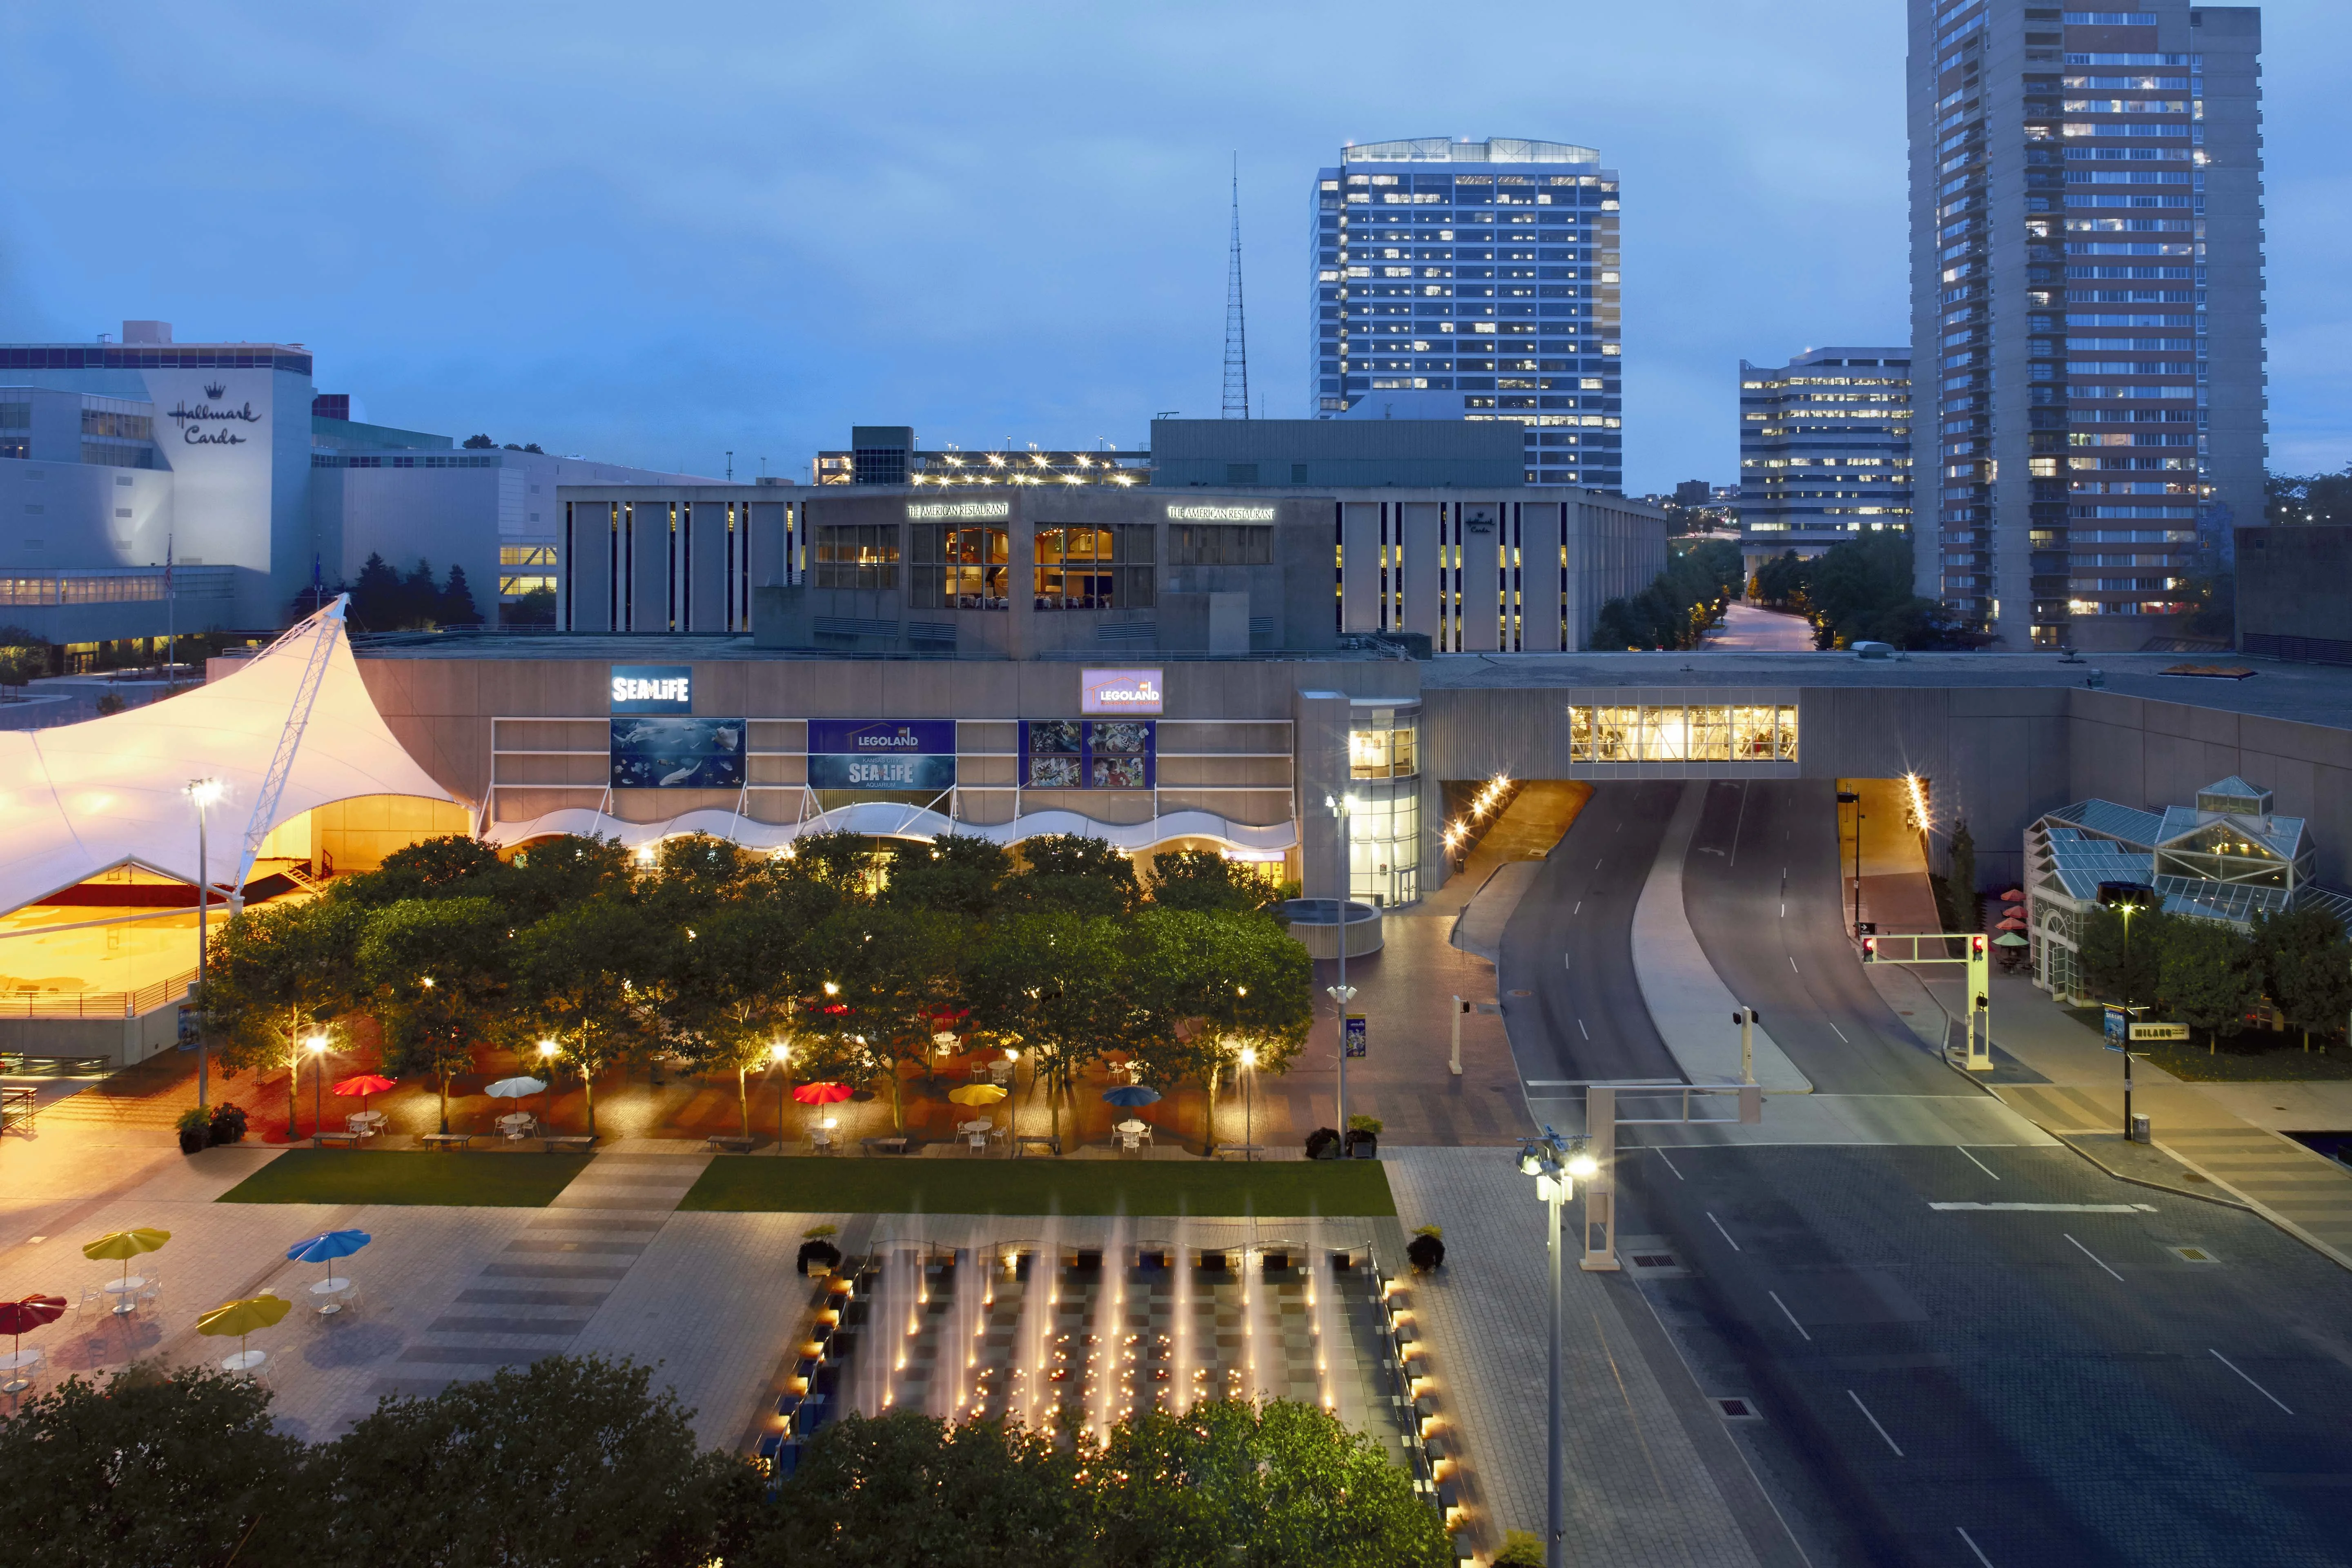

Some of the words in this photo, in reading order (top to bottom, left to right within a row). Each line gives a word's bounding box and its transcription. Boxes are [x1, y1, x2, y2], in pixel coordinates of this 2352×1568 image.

[167, 399, 262, 429] Hallmark
[185, 425, 246, 445] Cards
[907, 507, 920, 516] THE
[921, 506, 958, 516] AMERICAN
[960, 504, 1008, 515] RESTAURANT
[1169, 508, 1184, 517] THE
[1186, 508, 1227, 518] AMERICAN
[1229, 510, 1275, 519] RESTAURANT
[1465, 517, 1496, 528] Hallmark
[613, 677, 650, 702] SEA
[1100, 682, 1159, 700] LEGOLAND
[859, 727, 918, 746] LEGOLAND
[849, 763, 880, 783] SEA
[2135, 1029, 2172, 1038] MILANO
